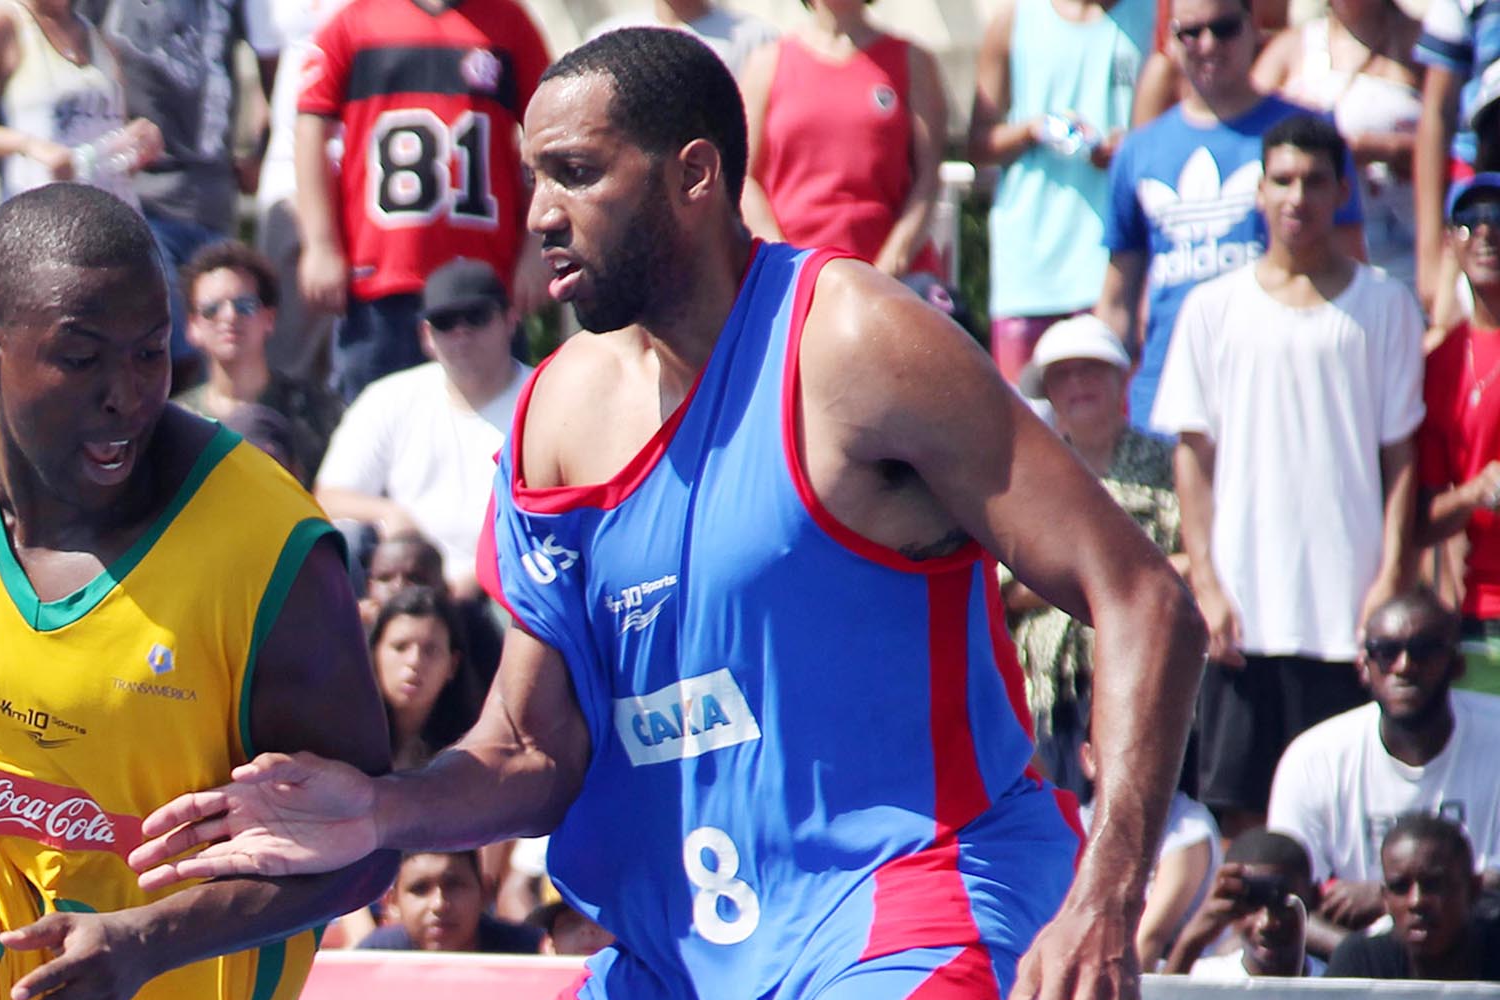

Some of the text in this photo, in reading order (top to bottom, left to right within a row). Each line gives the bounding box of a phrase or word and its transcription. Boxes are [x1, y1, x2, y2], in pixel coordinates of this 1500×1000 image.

[366, 108, 499, 232] 81
[642, 574, 677, 595] Sports
[112, 678, 197, 701] TRANSAMERICA
[0, 699, 88, 736] Km10 Sports
[683, 826, 760, 945] 8
